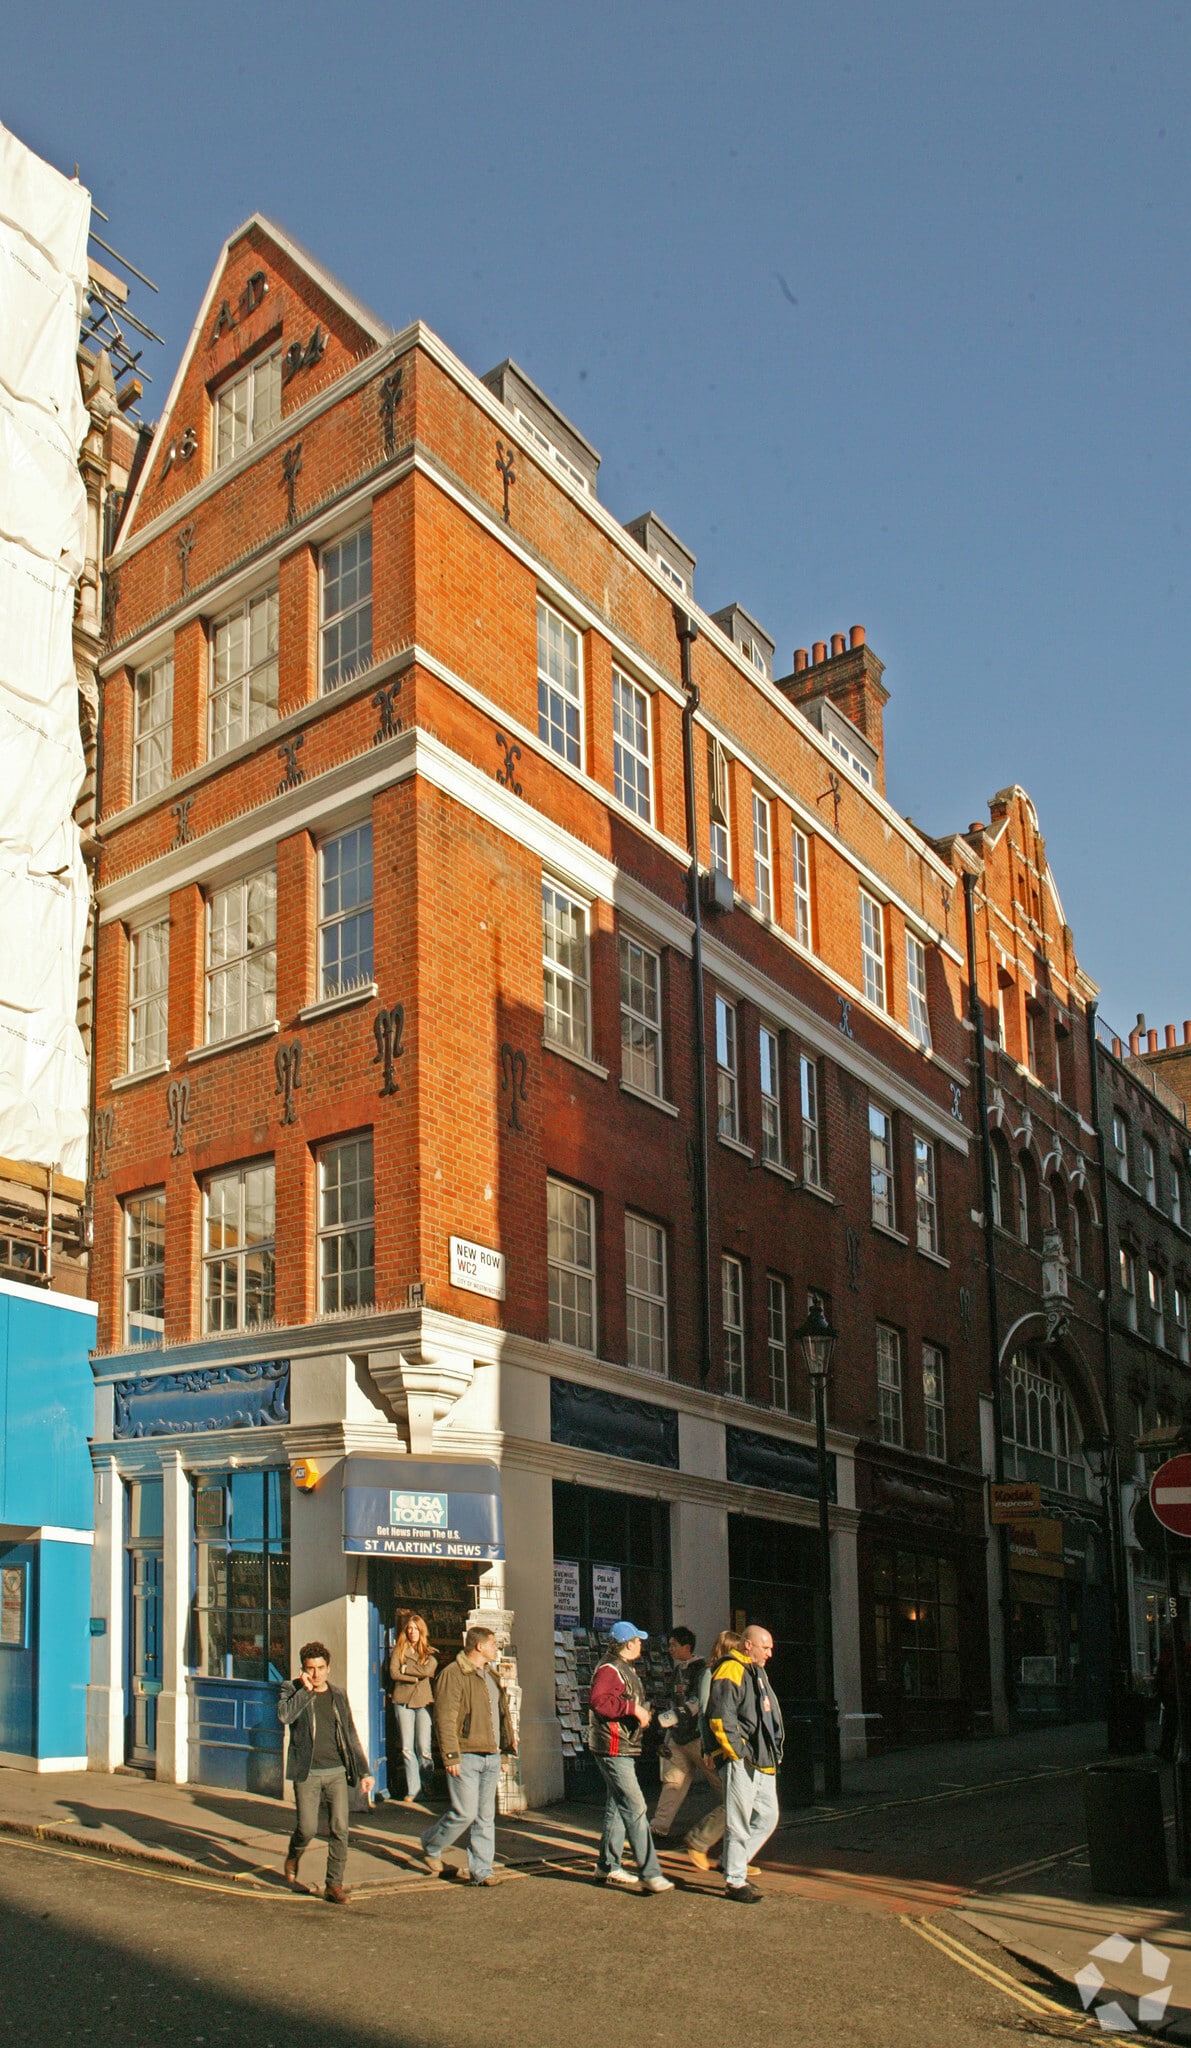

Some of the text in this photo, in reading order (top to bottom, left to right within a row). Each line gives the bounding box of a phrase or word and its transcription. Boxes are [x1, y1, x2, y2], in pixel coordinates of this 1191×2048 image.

[456, 1244, 500, 1269] NEW ROW
[457, 1259, 477, 1275] WC2
[412, 1495, 443, 1511] USA
[994, 1489, 1033, 1502] Kodak
[994, 1500, 1034, 1508] express
[393, 1507, 445, 1524] TODAY
[376, 1525, 461, 1540] Get News From The U.S.
[364, 1540, 482, 1556] ST MARTIN'S NEWS
[597, 1575, 614, 1583] POLICE
